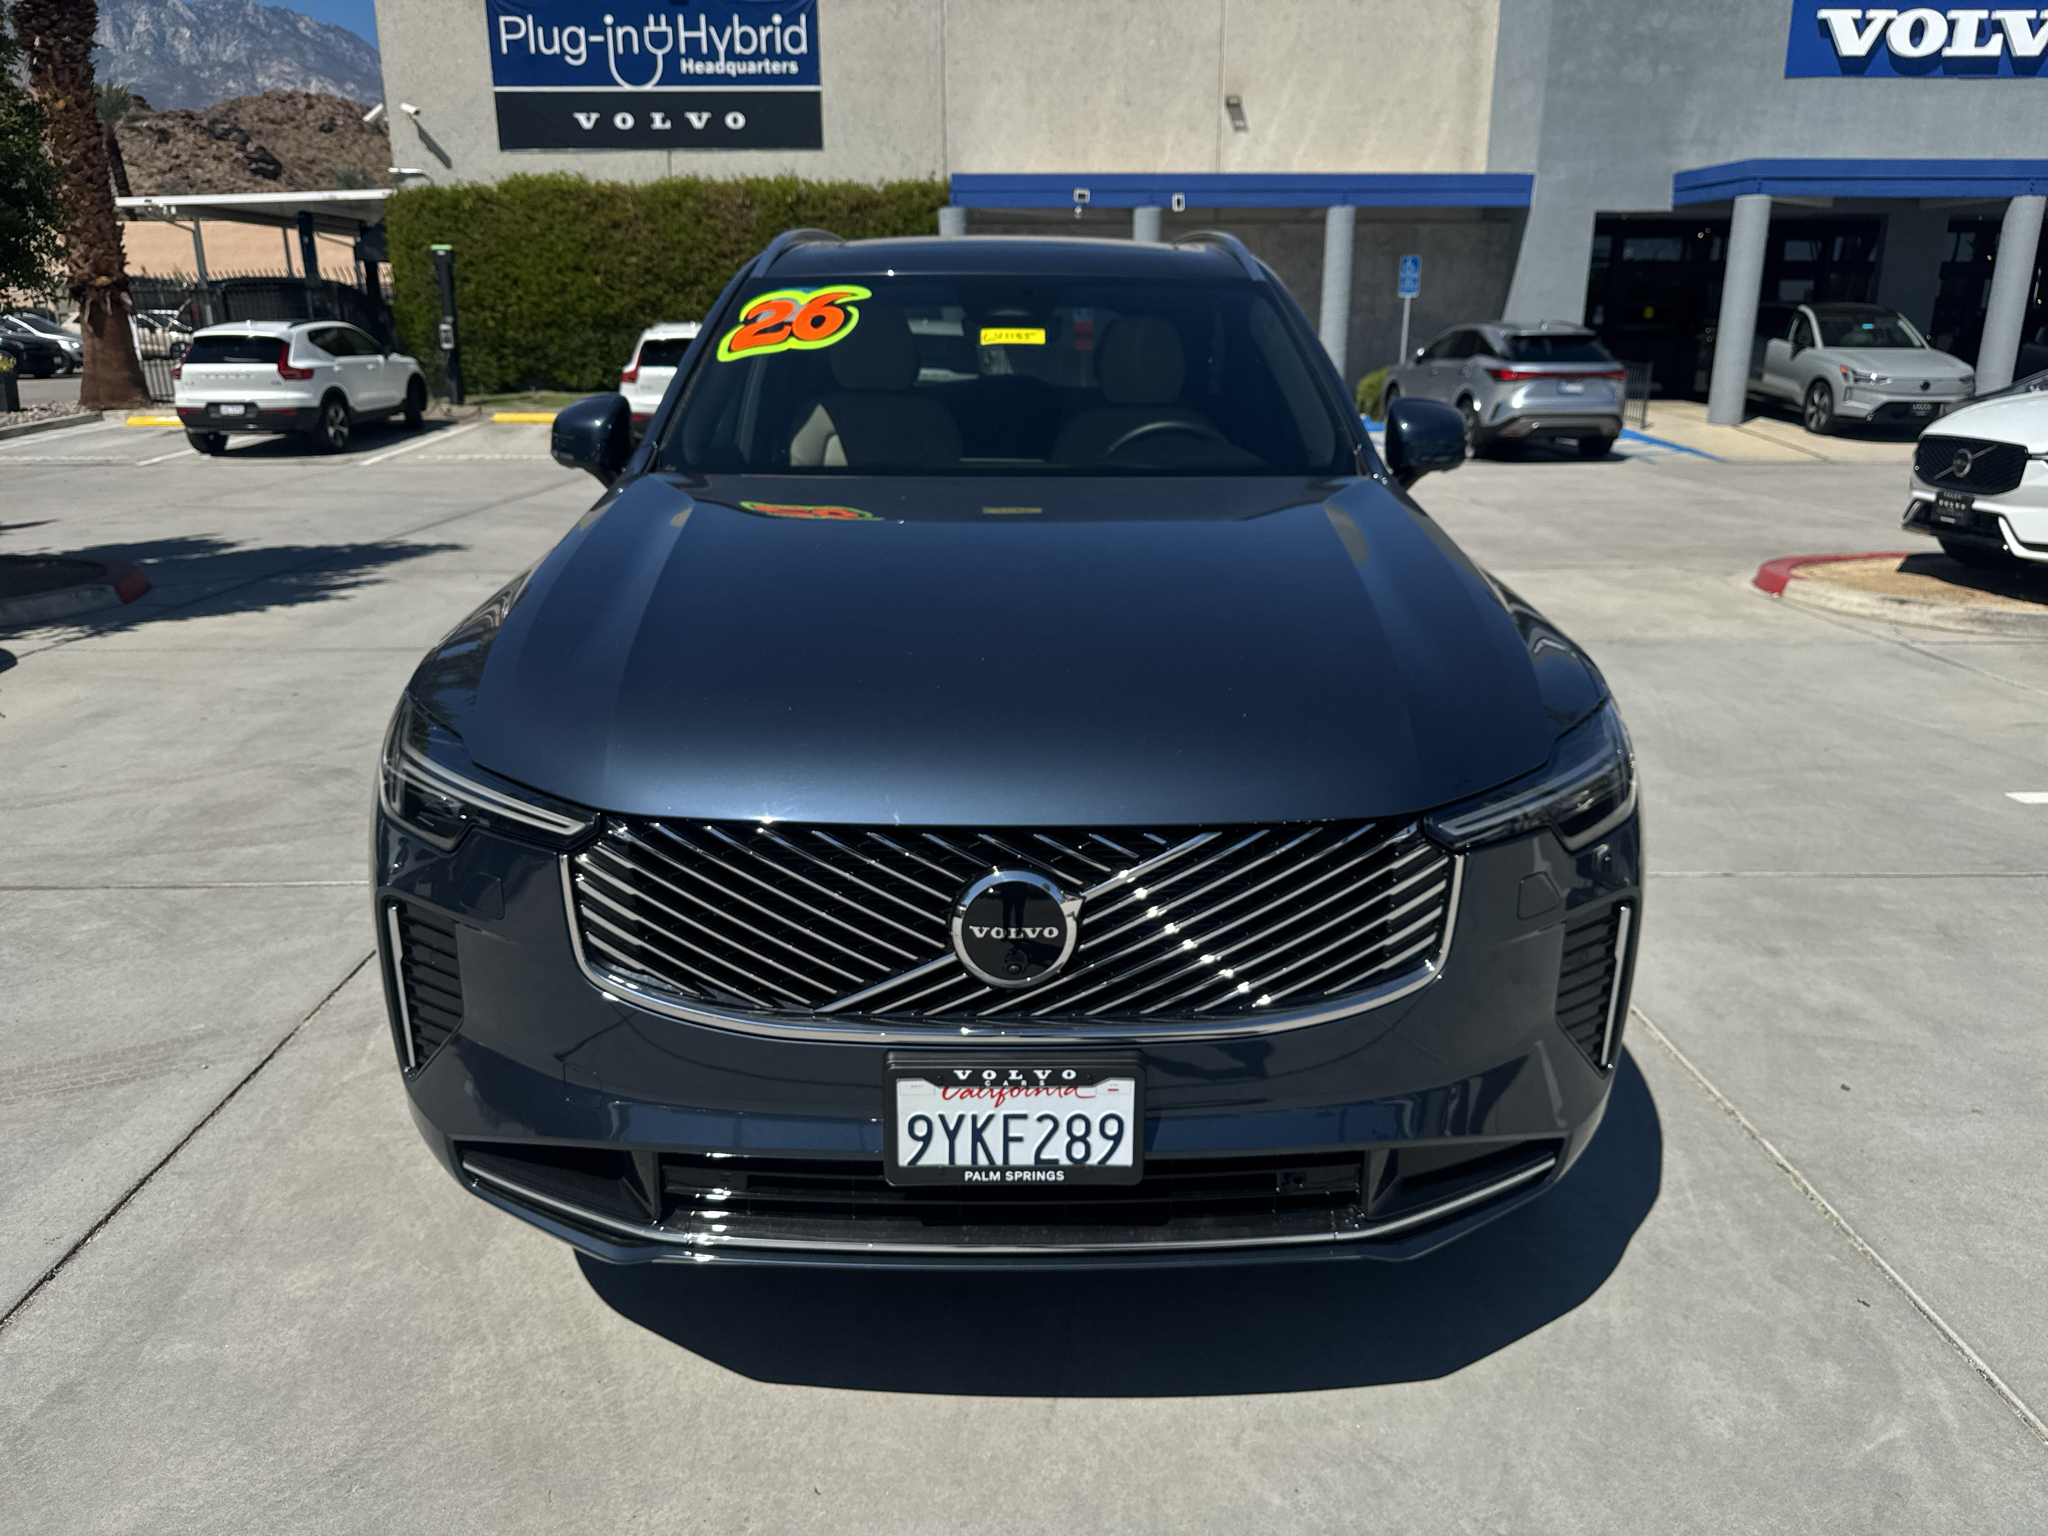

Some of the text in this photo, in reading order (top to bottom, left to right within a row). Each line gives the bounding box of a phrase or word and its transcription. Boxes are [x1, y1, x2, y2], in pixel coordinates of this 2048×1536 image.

[498, 13, 808, 66] Plug-in Hybrid
[680, 58, 799, 76] Headquarters
[573, 111, 747, 131] VOLVO
[728, 290, 853, 352] 26
[969, 926, 1059, 939] VOLVO
[953, 1069, 1077, 1081] VOLVO
[984, 1079, 1046, 1087] CARS
[942, 1085, 1096, 1108] California
[906, 1112, 1125, 1167] 9YKF289
[964, 1171, 1065, 1182] PALM SPRINGS
